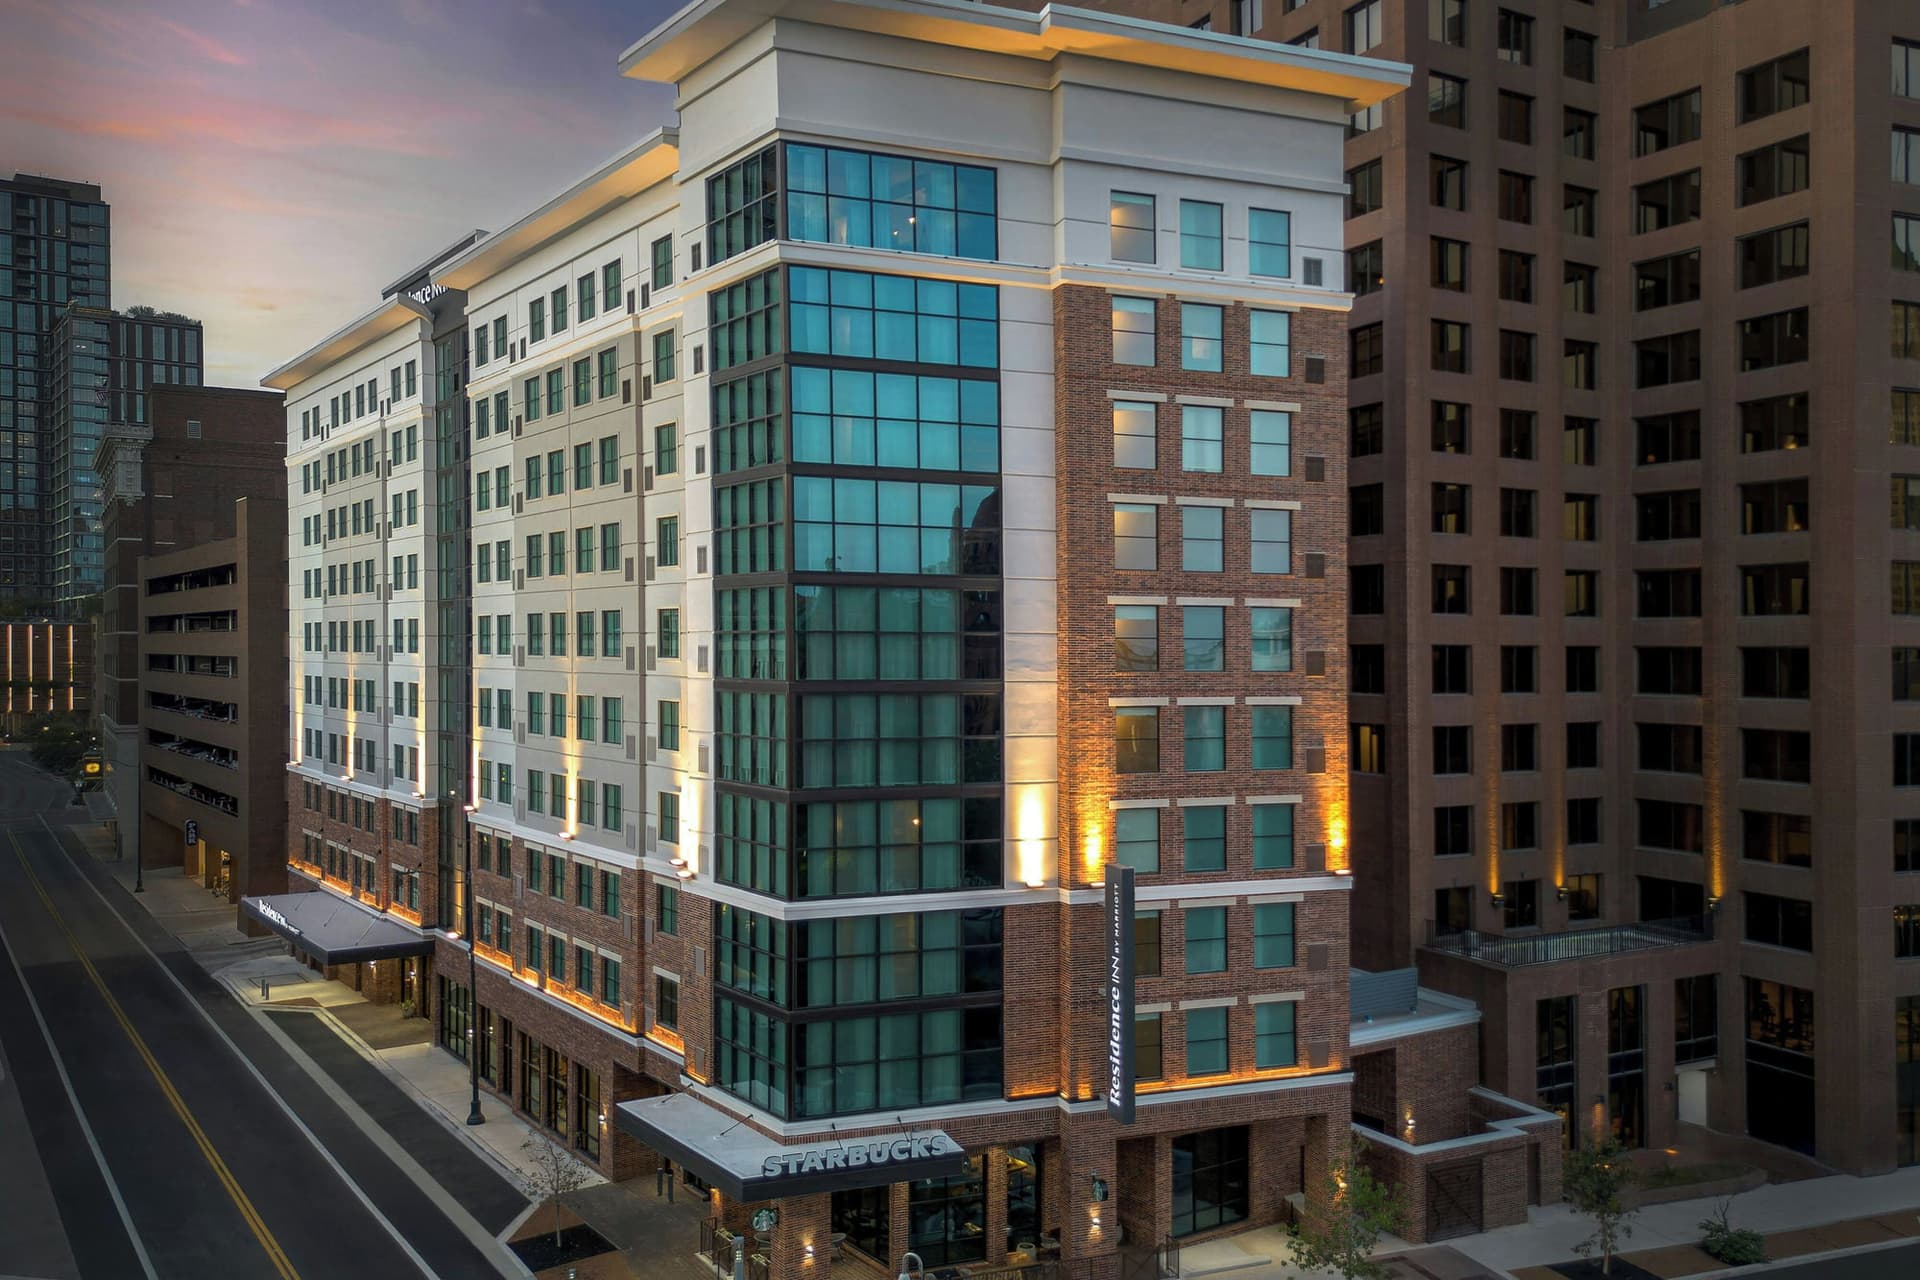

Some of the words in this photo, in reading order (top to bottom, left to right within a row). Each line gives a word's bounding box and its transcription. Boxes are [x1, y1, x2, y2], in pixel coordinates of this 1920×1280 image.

[1113, 940, 1120, 954] BY
[1111, 955, 1121, 984] INN
[1110, 986, 1121, 1107] Residence
[762, 1134, 949, 1177] STARBUCKS
